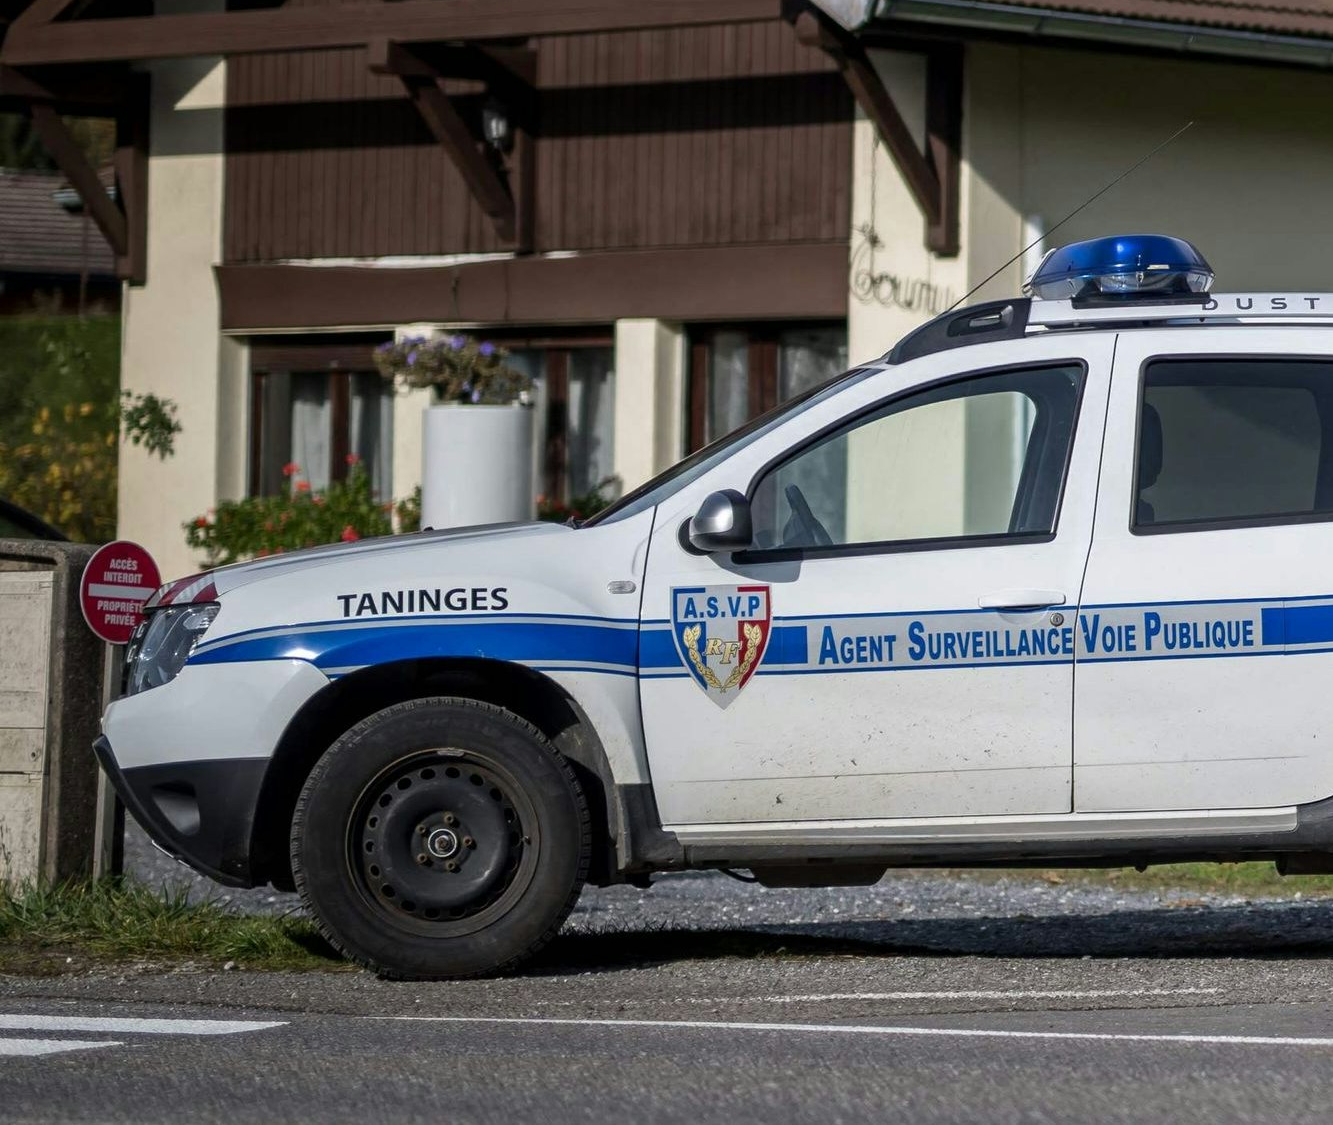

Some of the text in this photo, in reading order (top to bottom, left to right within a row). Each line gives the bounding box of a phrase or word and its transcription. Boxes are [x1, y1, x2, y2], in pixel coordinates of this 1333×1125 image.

[103, 571, 143, 584] INTERDIT
[336, 587, 509, 618] TANINGES
[684, 595, 760, 618] A.S.V.P
[104, 613, 136, 626] PRIVÉE
